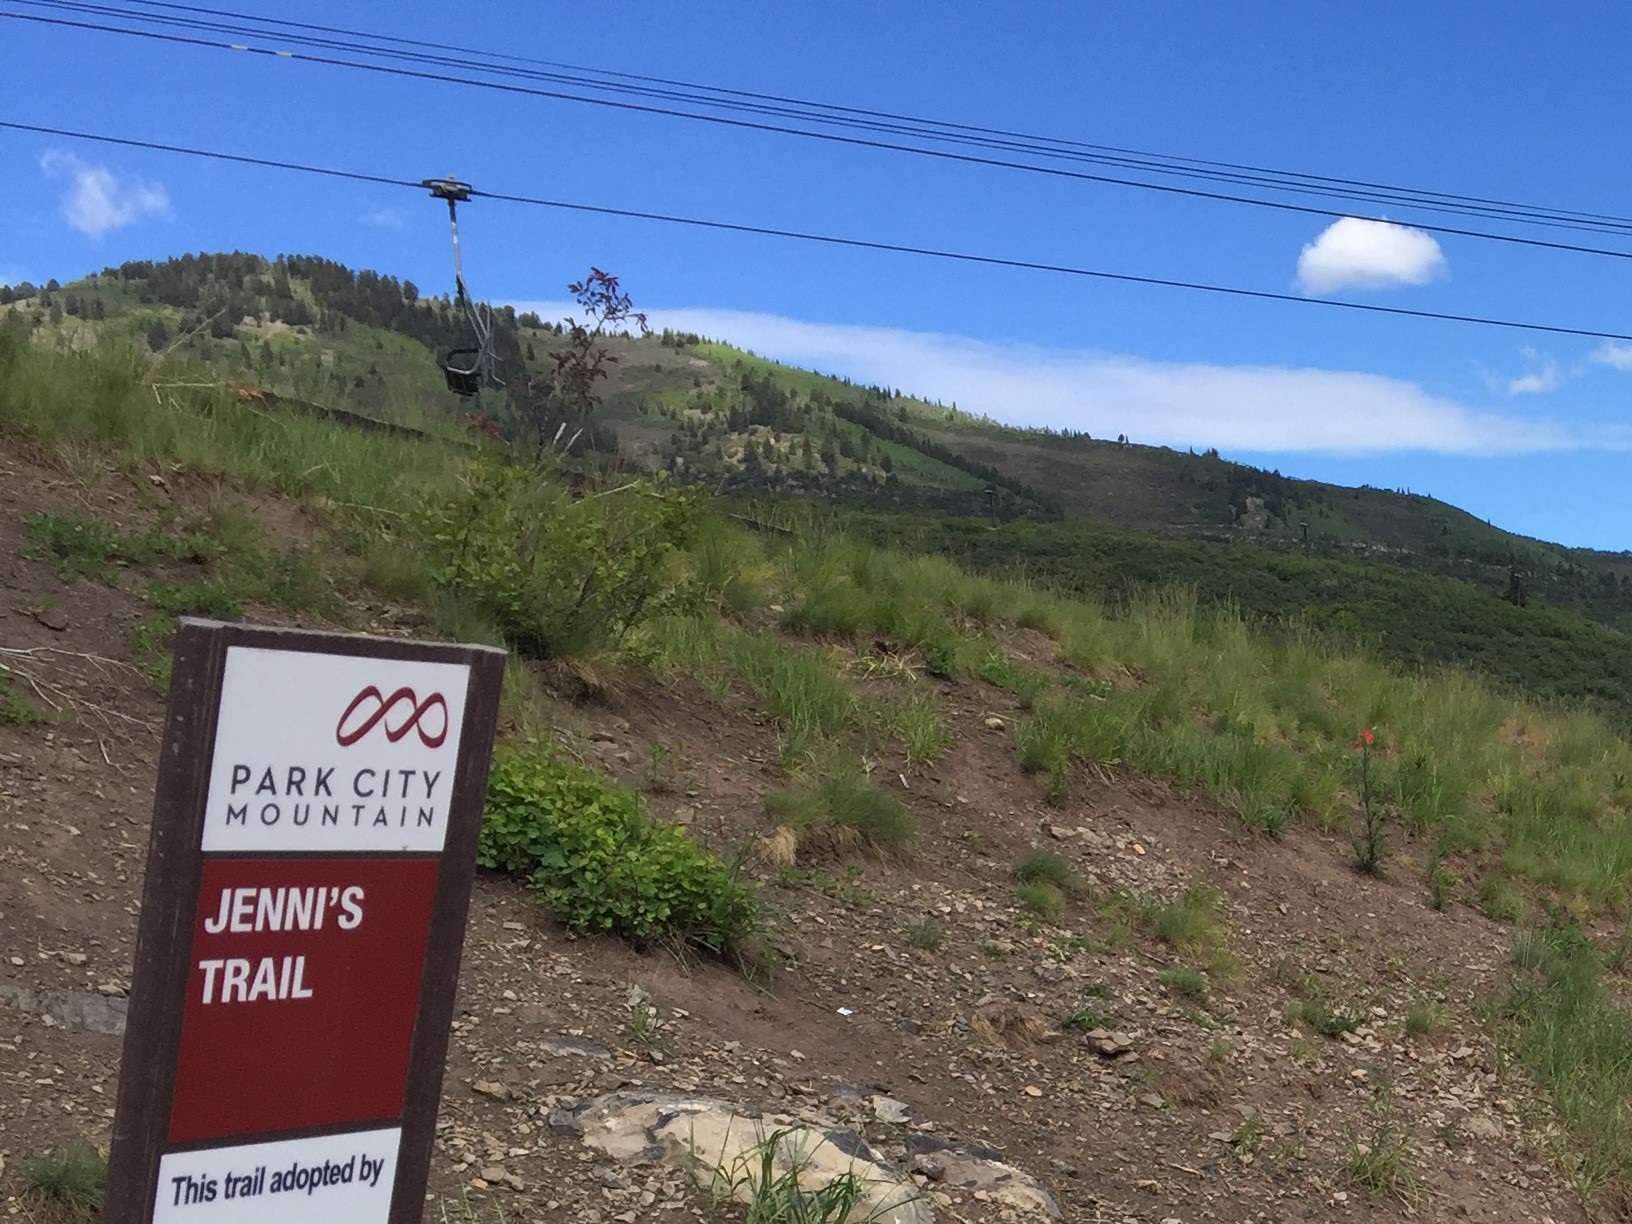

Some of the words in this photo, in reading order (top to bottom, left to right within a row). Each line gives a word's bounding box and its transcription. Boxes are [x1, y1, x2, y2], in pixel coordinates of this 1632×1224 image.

[231, 764, 335, 797] PARK
[353, 768, 441, 799] CITY
[225, 803, 434, 827] MOUNTAIN
[204, 886, 365, 934] JENNI'S
[198, 955, 313, 1004] TRAIL
[171, 1173, 218, 1206] This
[224, 1166, 266, 1200] trail
[270, 1155, 355, 1195] adopted
[358, 1154, 385, 1187] by
